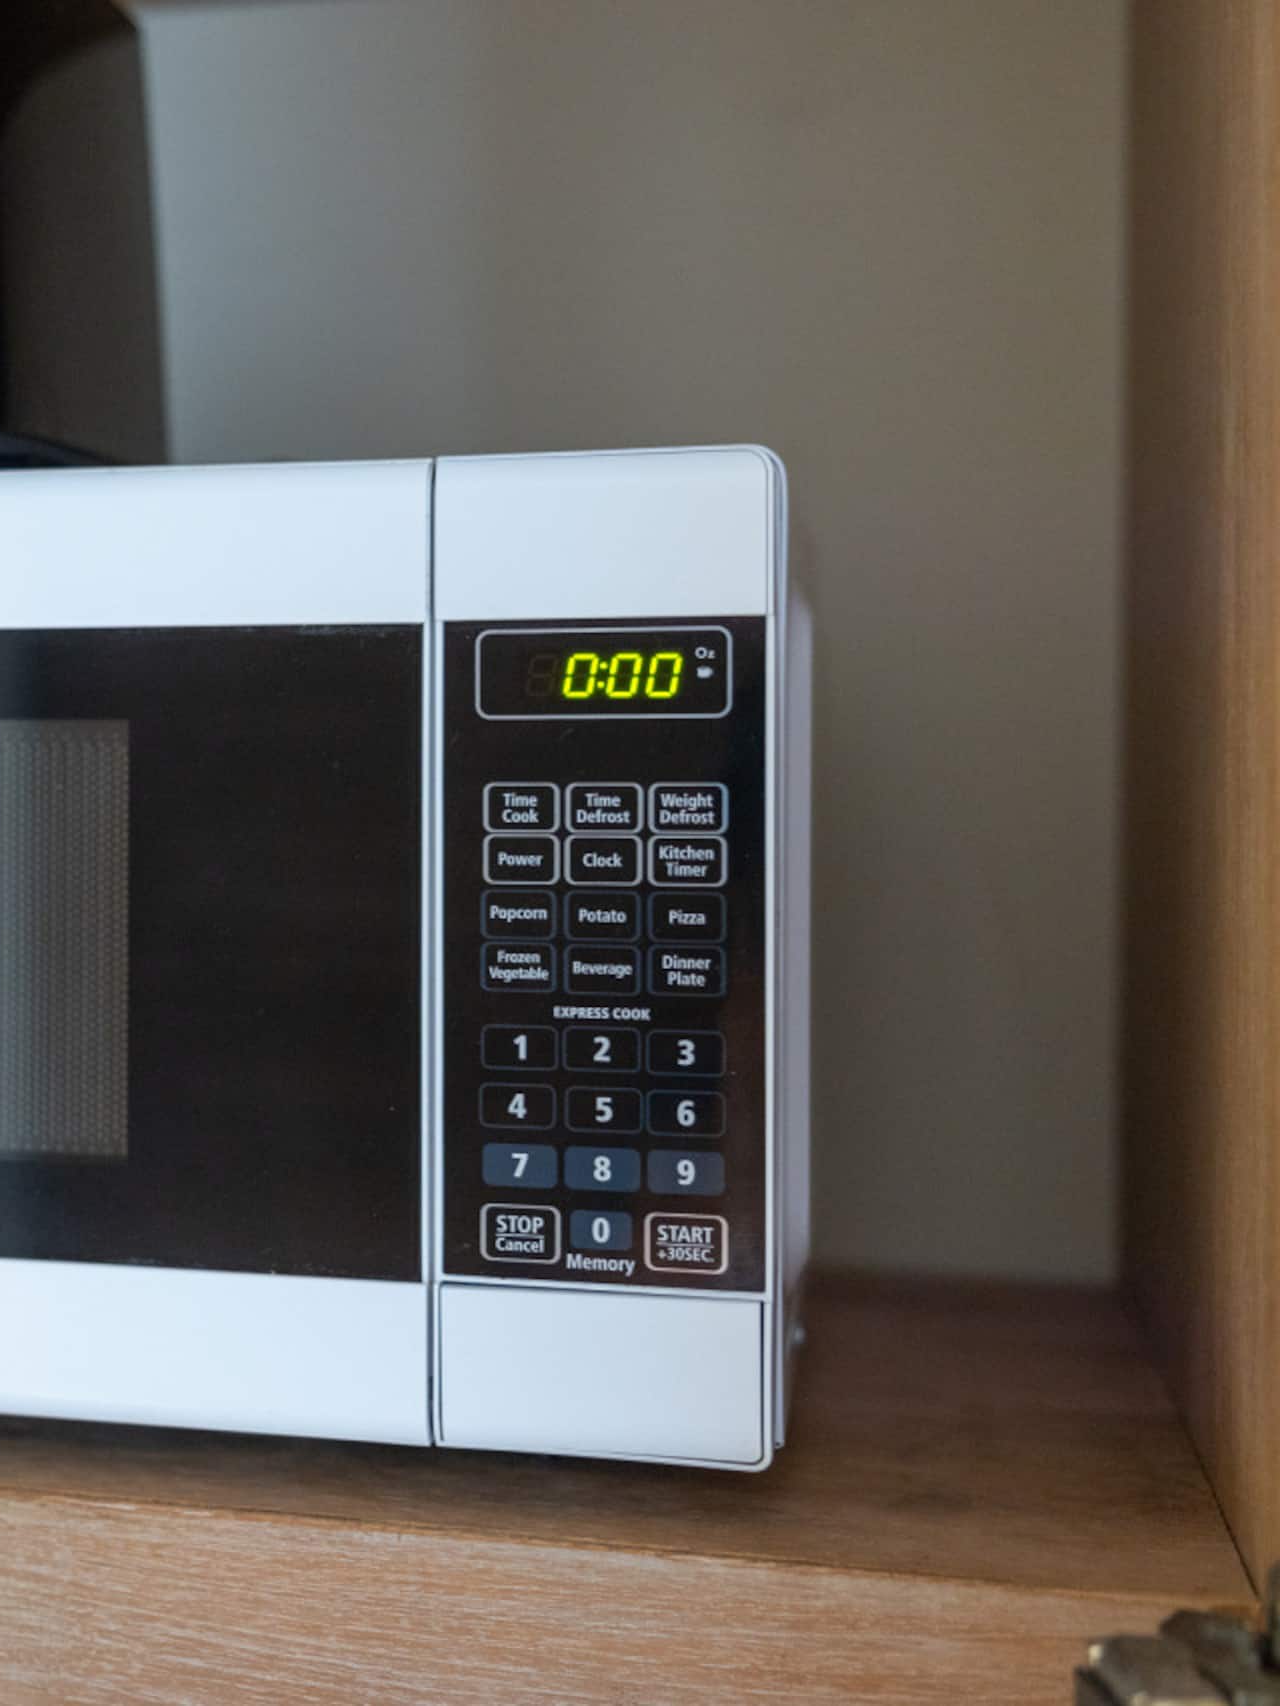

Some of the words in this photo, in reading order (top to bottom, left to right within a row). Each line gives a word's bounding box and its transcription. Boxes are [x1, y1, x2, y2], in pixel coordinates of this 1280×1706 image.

[563, 652, 683, 698] 0:00
[503, 793, 537, 808] Time
[585, 793, 620, 808] Time
[660, 793, 713, 810] Weight
[502, 810, 538, 824] Cook
[577, 810, 630, 824] Defrost
[659, 811, 714, 825] Defrost
[497, 853, 542, 867] Power
[583, 854, 622, 868] Clock
[659, 846, 714, 860] Kitchen
[666, 863, 707, 877] Timer
[490, 906, 547, 922] Popcorn
[579, 909, 626, 924] Potato
[669, 910, 705, 925] Pizza
[497, 951, 540, 963] Frozen
[662, 955, 711, 970] Dinner
[489, 966, 549, 983] Vegetable
[573, 961, 632, 978] Beverage
[667, 971, 705, 987] Plate
[553, 1006, 609, 1019] EXPRESS
[613, 1007, 651, 1021] COOK
[513, 1034, 527, 1060] 1
[593, 1036, 611, 1062] 2
[677, 1039, 695, 1066] 3
[507, 1093, 527, 1119] 4
[595, 1097, 613, 1122] 5
[677, 1100, 695, 1126] 6
[511, 1153, 529, 1178] 7
[593, 1156, 611, 1182] 8
[677, 1160, 695, 1185] 9
[496, 1215, 544, 1233] STOP
[592, 1217, 610, 1243] 0
[657, 1225, 714, 1243] START
[495, 1237, 544, 1253] Cancel
[567, 1253, 635, 1276] Memory
